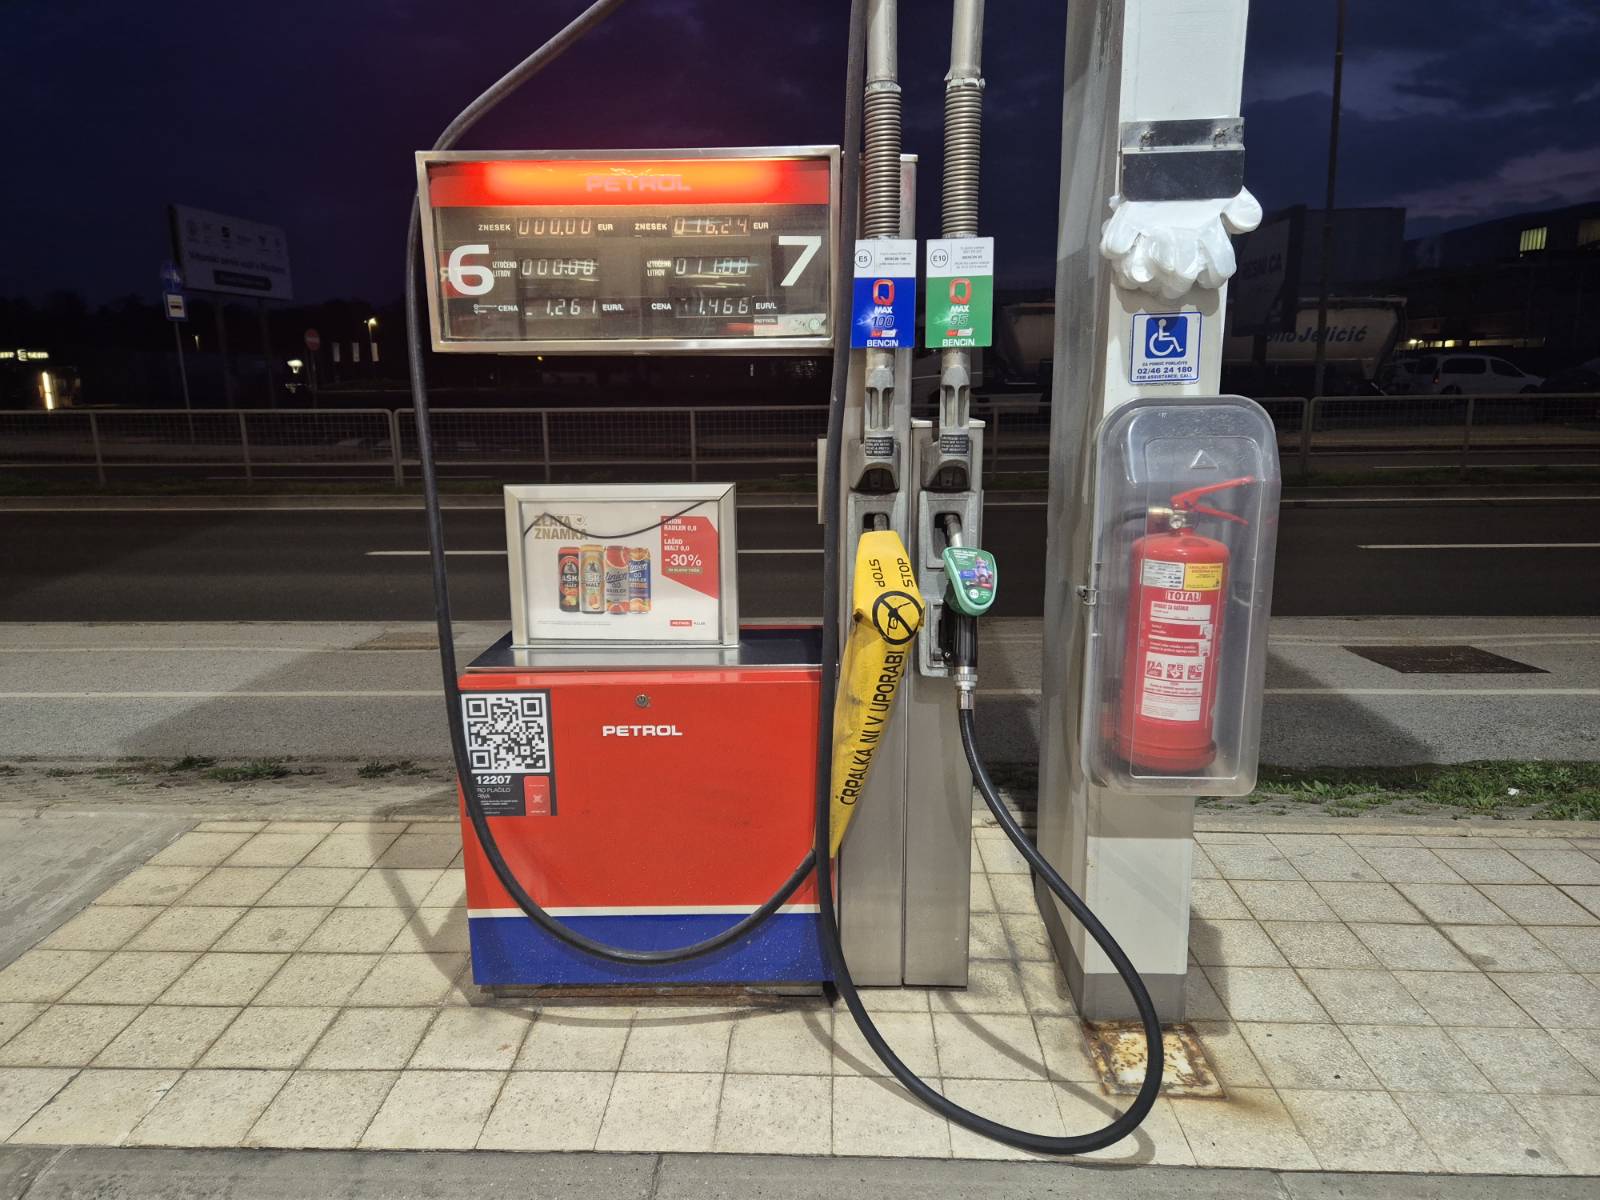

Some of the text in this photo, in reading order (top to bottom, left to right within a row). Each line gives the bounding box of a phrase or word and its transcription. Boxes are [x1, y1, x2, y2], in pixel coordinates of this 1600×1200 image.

[586, 175, 692, 192] PETROL
[478, 223, 511, 231] ZNESEK
[597, 223, 613, 231] EUR
[634, 223, 668, 231] ZNESEK
[753, 222, 769, 230] EUR
[778, 235, 822, 287] 7
[858, 255, 868, 263] E5
[448, 244, 495, 296] 6
[872, 279, 895, 306] Q
[949, 278, 972, 305] Q
[498, 304, 519, 312] CENA
[602, 304, 624, 312] EUR/L
[651, 302, 672, 310] CENA
[755, 302, 776, 310] EUR/L
[873, 306, 893, 314] MAX
[950, 304, 970, 313] MAX
[871, 315, 895, 327] 100
[950, 314, 969, 326] 95
[867, 339, 899, 347] BENCIN
[942, 338, 975, 347] BENCIN
[534, 527, 588, 540] ZNAMKA
[664, 553, 702, 567] -30%
[868, 558, 886, 588] STOP
[896, 557, 914, 588] STOP
[1169, 591, 1199, 600] TOTAL
[871, 650, 905, 712] UPORABI
[864, 715, 885, 726] V
[602, 725, 683, 737] PETROL
[859, 729, 881, 743] NI
[475, 775, 512, 785] 12207
